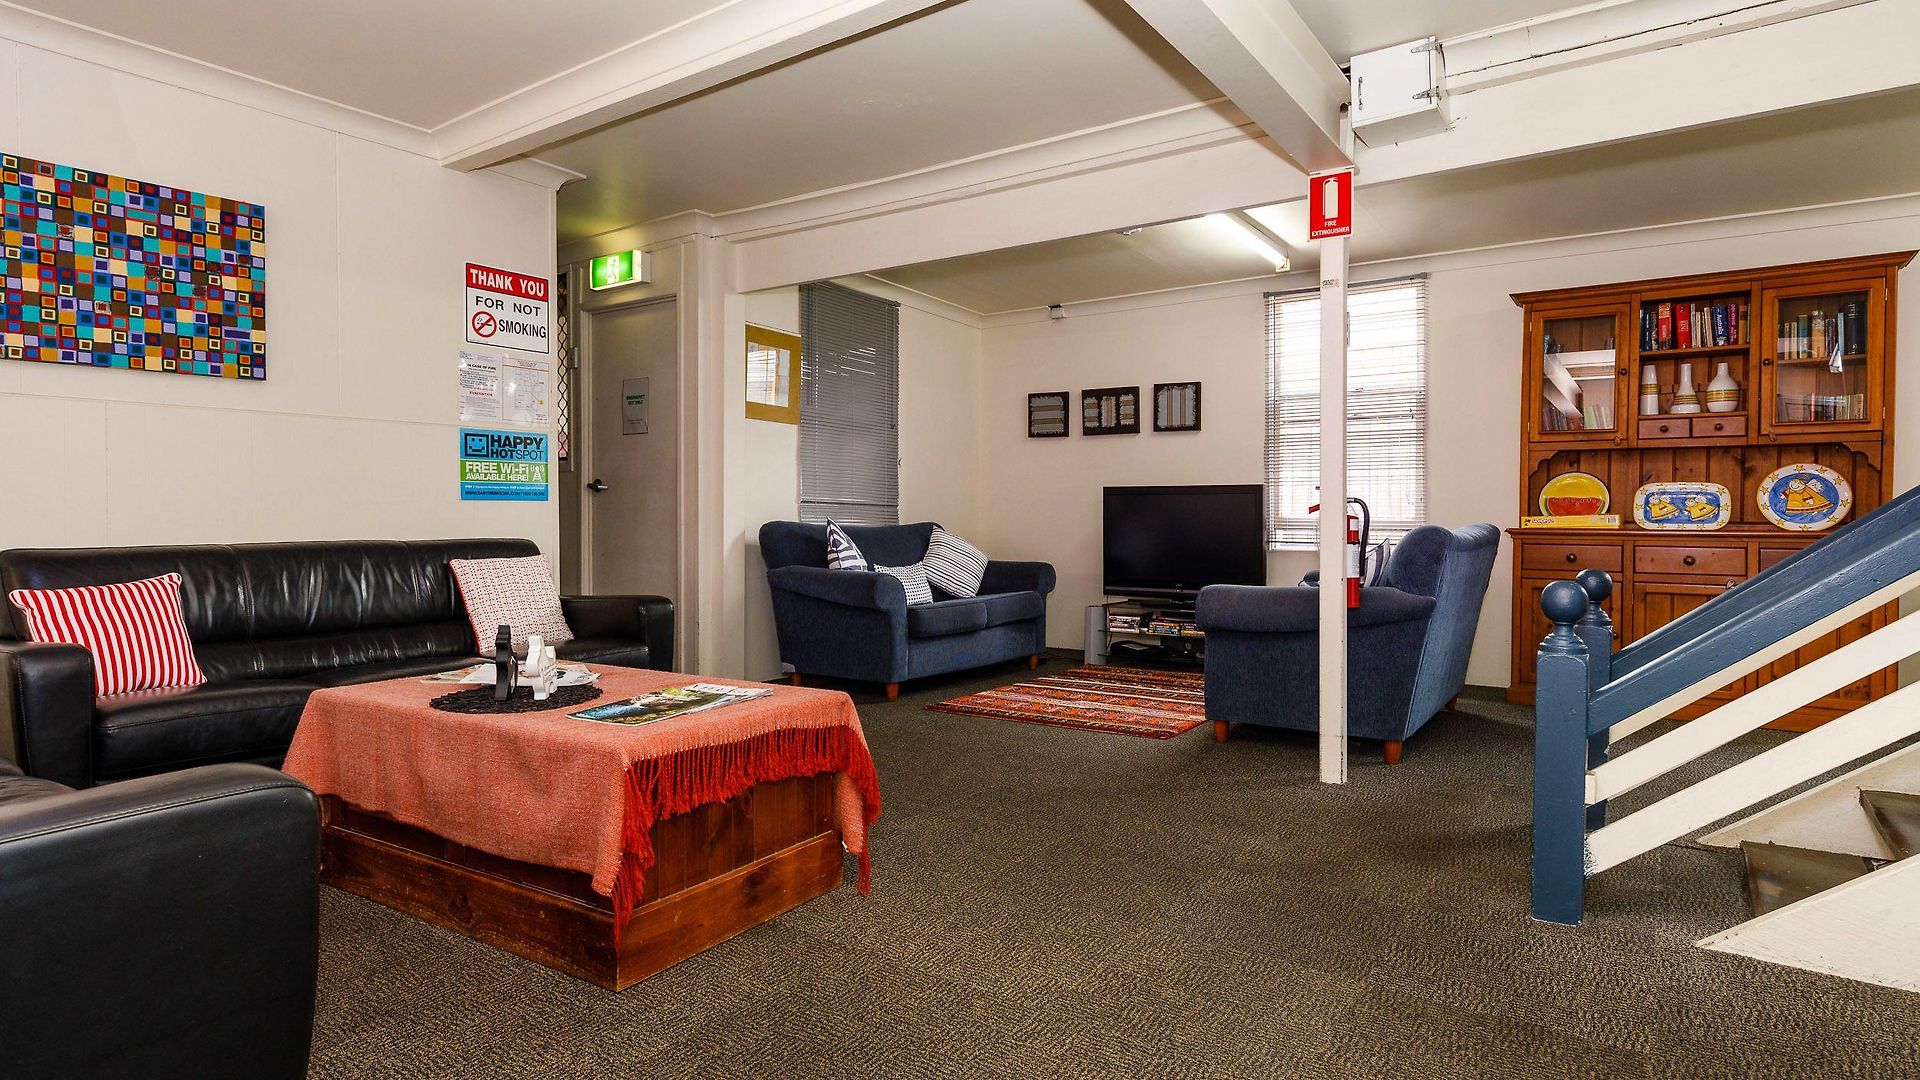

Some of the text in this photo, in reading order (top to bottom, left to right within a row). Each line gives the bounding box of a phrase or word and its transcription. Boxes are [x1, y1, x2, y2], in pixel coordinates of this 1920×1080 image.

[1311, 226, 1350, 237] EXTINGUISHER
[470, 268, 544, 297] THANK YOU
[475, 295, 541, 316] FOR NOT
[498, 319, 546, 339] SMOKING
[490, 434, 544, 450] HAPPY
[490, 449, 544, 460] HOTSPOT
[465, 462, 529, 475] FREE Wi-Fi
[465, 473, 529, 482] AVAILABLE HERE!
